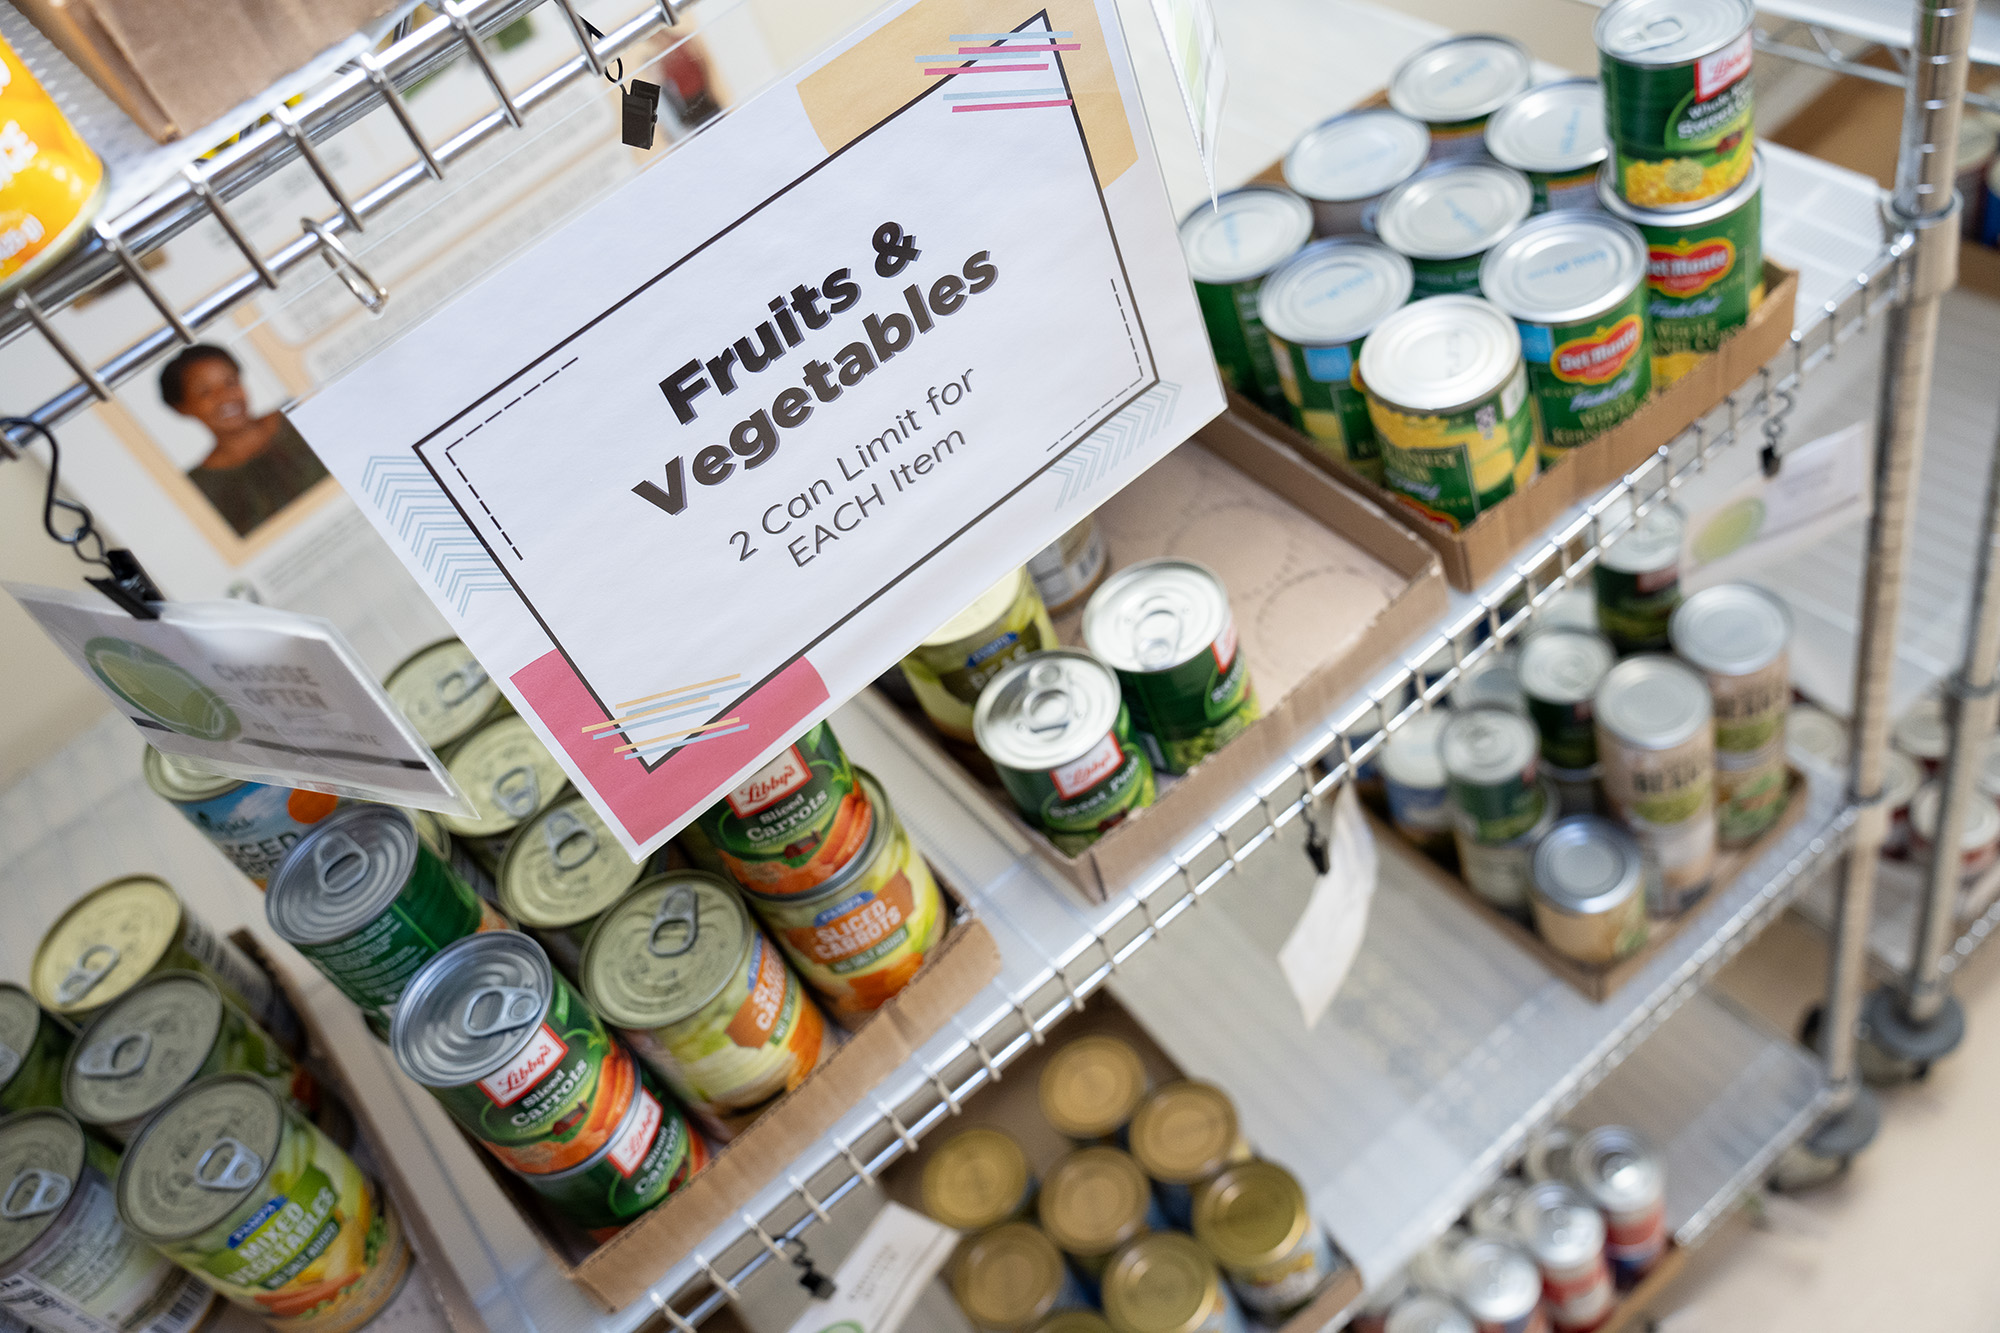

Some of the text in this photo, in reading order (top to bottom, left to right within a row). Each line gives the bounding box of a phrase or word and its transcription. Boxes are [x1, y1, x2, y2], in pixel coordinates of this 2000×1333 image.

[658, 221, 922, 425] Fruits &
[631, 250, 999, 516] Vegetables
[729, 368, 973, 561] 2 Can Limit for
[788, 430, 966, 567] EACH Item
[740, 765, 795, 806] Libby's
[760, 793, 805, 824] Sliced
[746, 790, 827, 841] Carrots
[814, 905, 901, 959] CARROTS
[816, 900, 887, 942] SLICED
[497, 1044, 551, 1096] Libby's
[511, 1058, 587, 1127] Carrots
[521, 1069, 566, 1108] Sliced
[226, 1186, 334, 1285] VEGETABLES
[239, 1202, 304, 1260] MIXED
